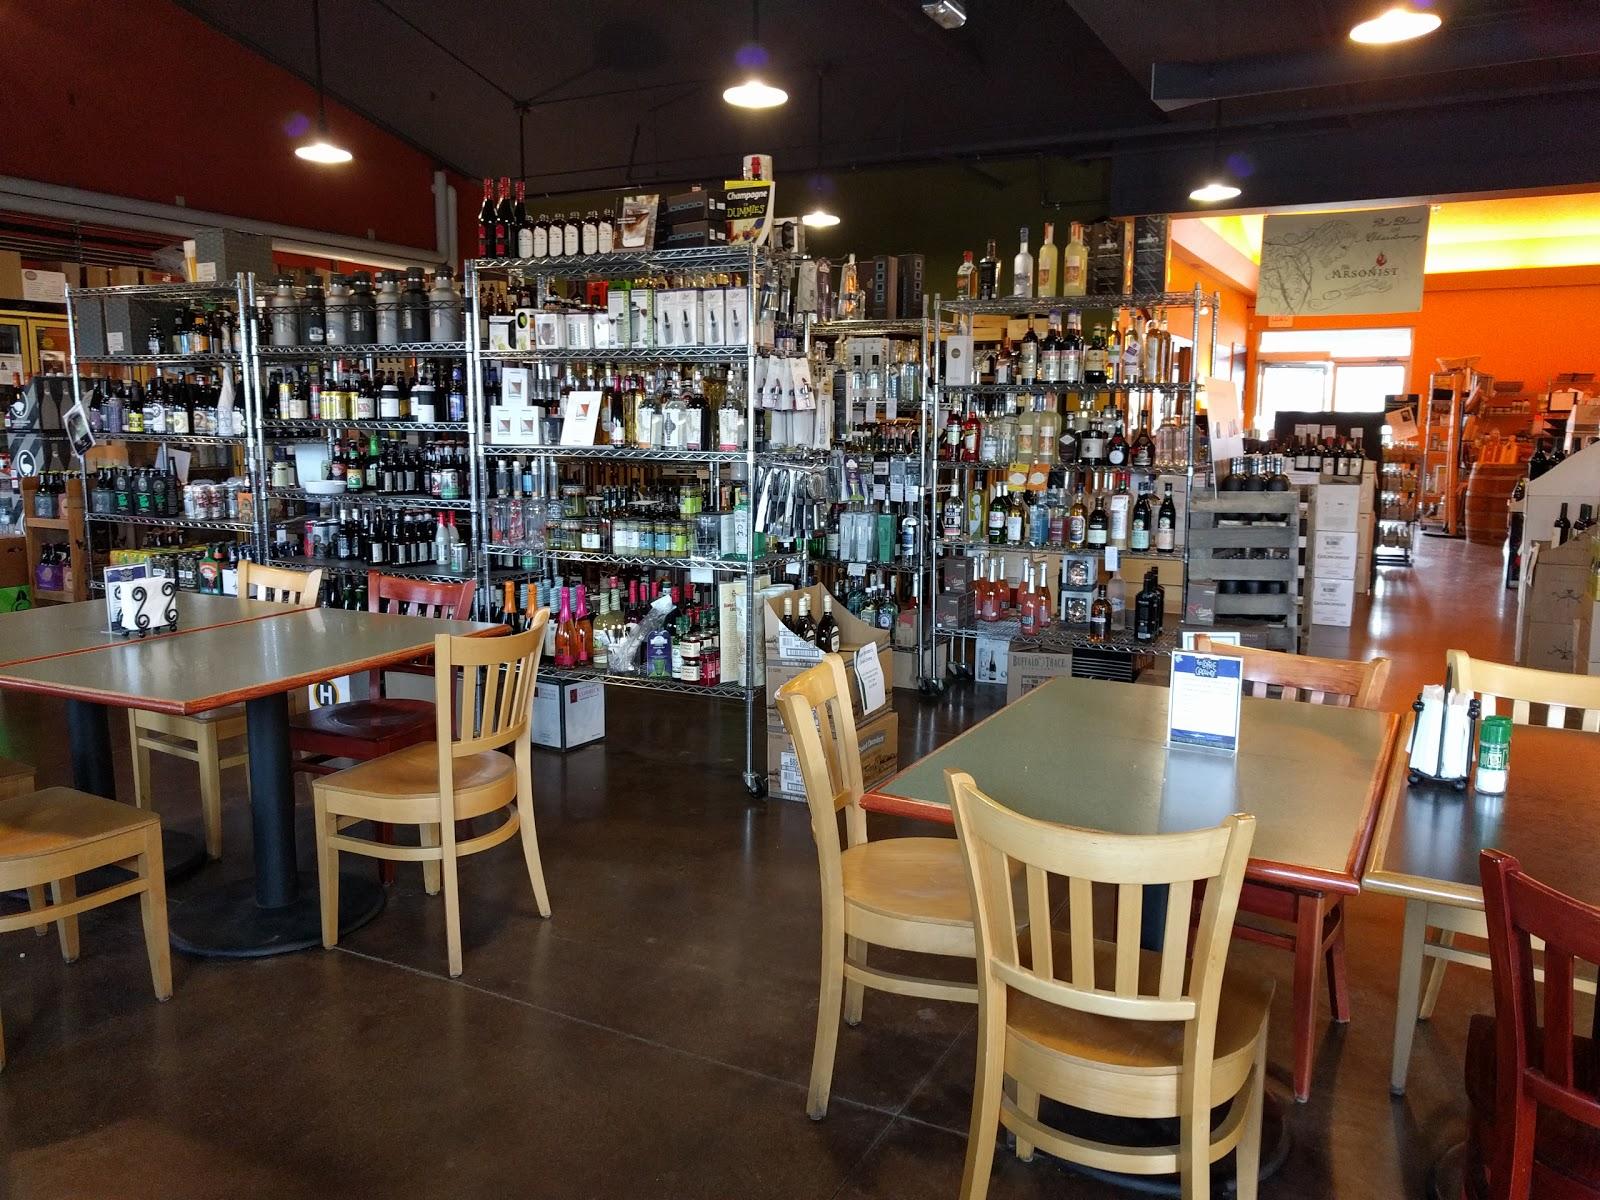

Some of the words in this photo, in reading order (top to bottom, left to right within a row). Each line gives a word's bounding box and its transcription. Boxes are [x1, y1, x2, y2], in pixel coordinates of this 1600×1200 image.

[726, 190, 768, 201] Champagne
[726, 204, 766, 218] DUMMIES
[1331, 267, 1400, 279] ARSONIST
